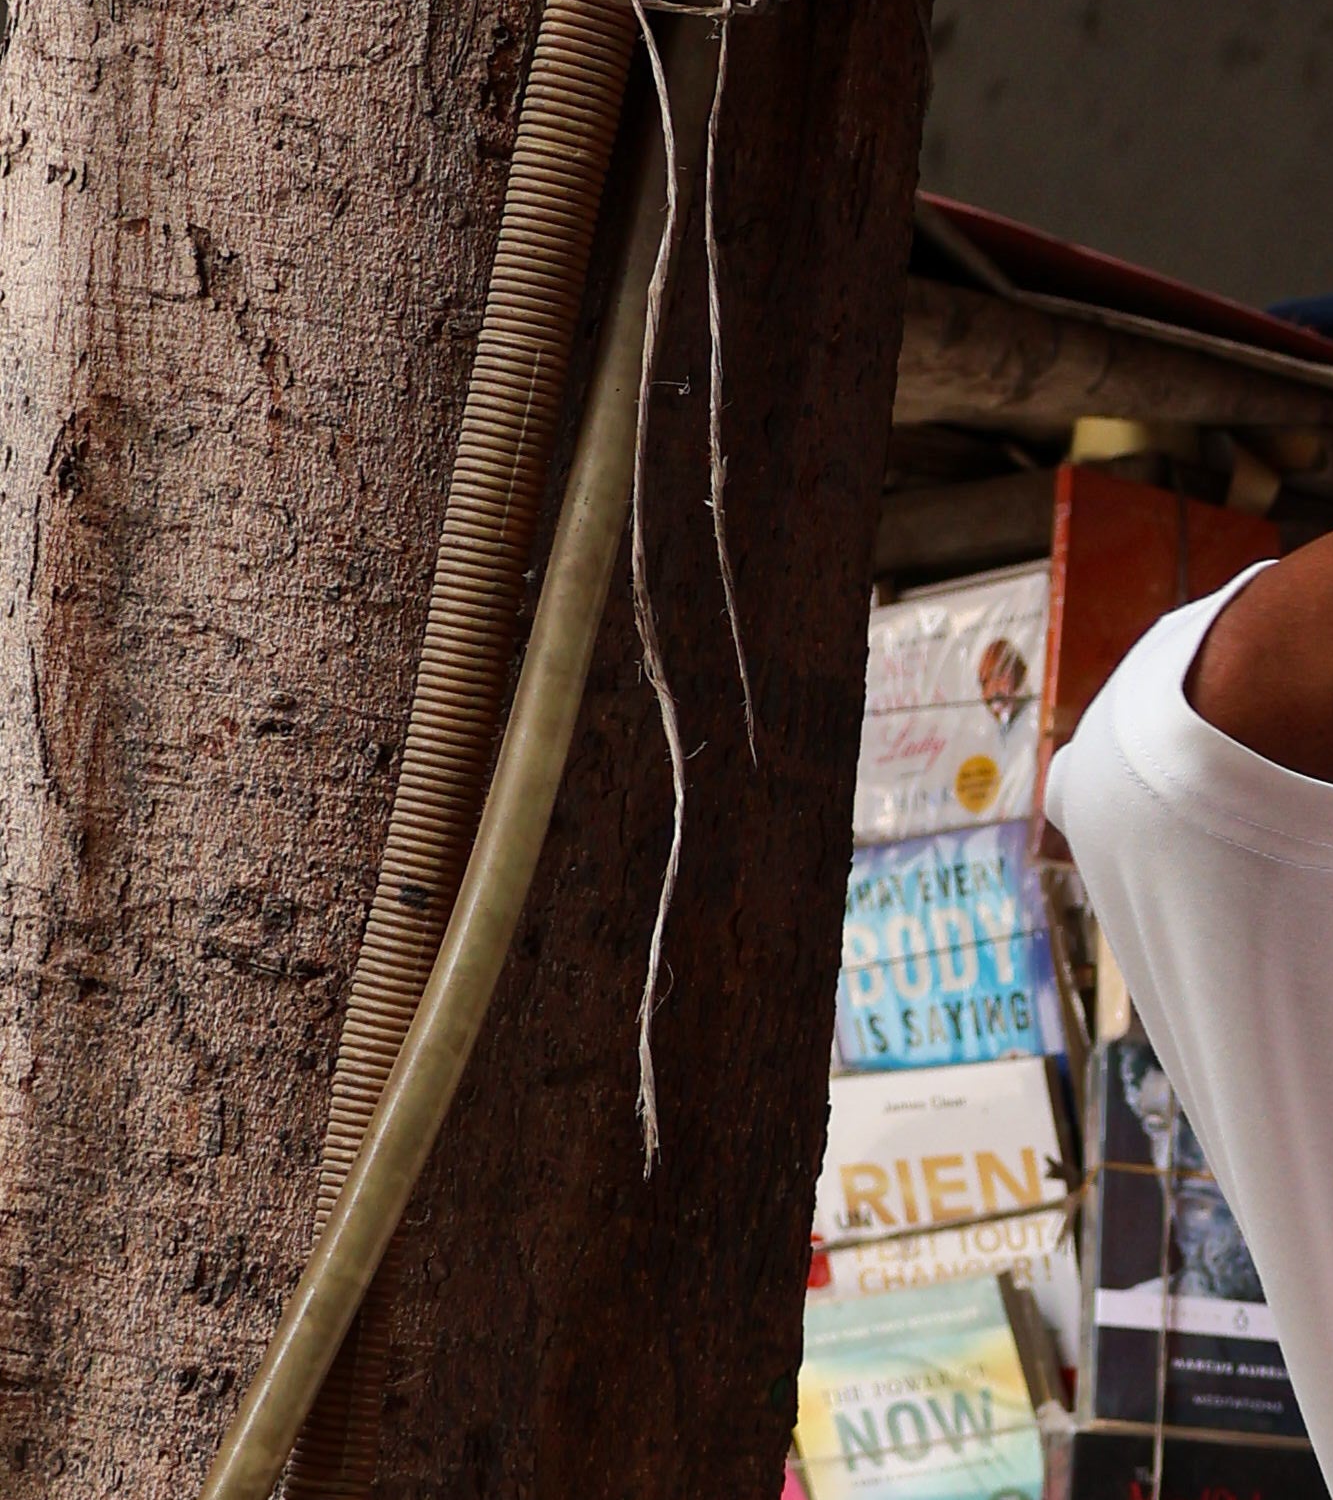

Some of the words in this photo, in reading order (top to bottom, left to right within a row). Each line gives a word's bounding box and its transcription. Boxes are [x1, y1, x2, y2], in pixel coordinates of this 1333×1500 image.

[843, 897, 1017, 1007] BODY
[853, 1011, 889, 1056] IS
[901, 991, 1030, 1050] SAYING
[839, 1146, 1044, 1229] RIEN
[834, 1386, 993, 1473] NOW
